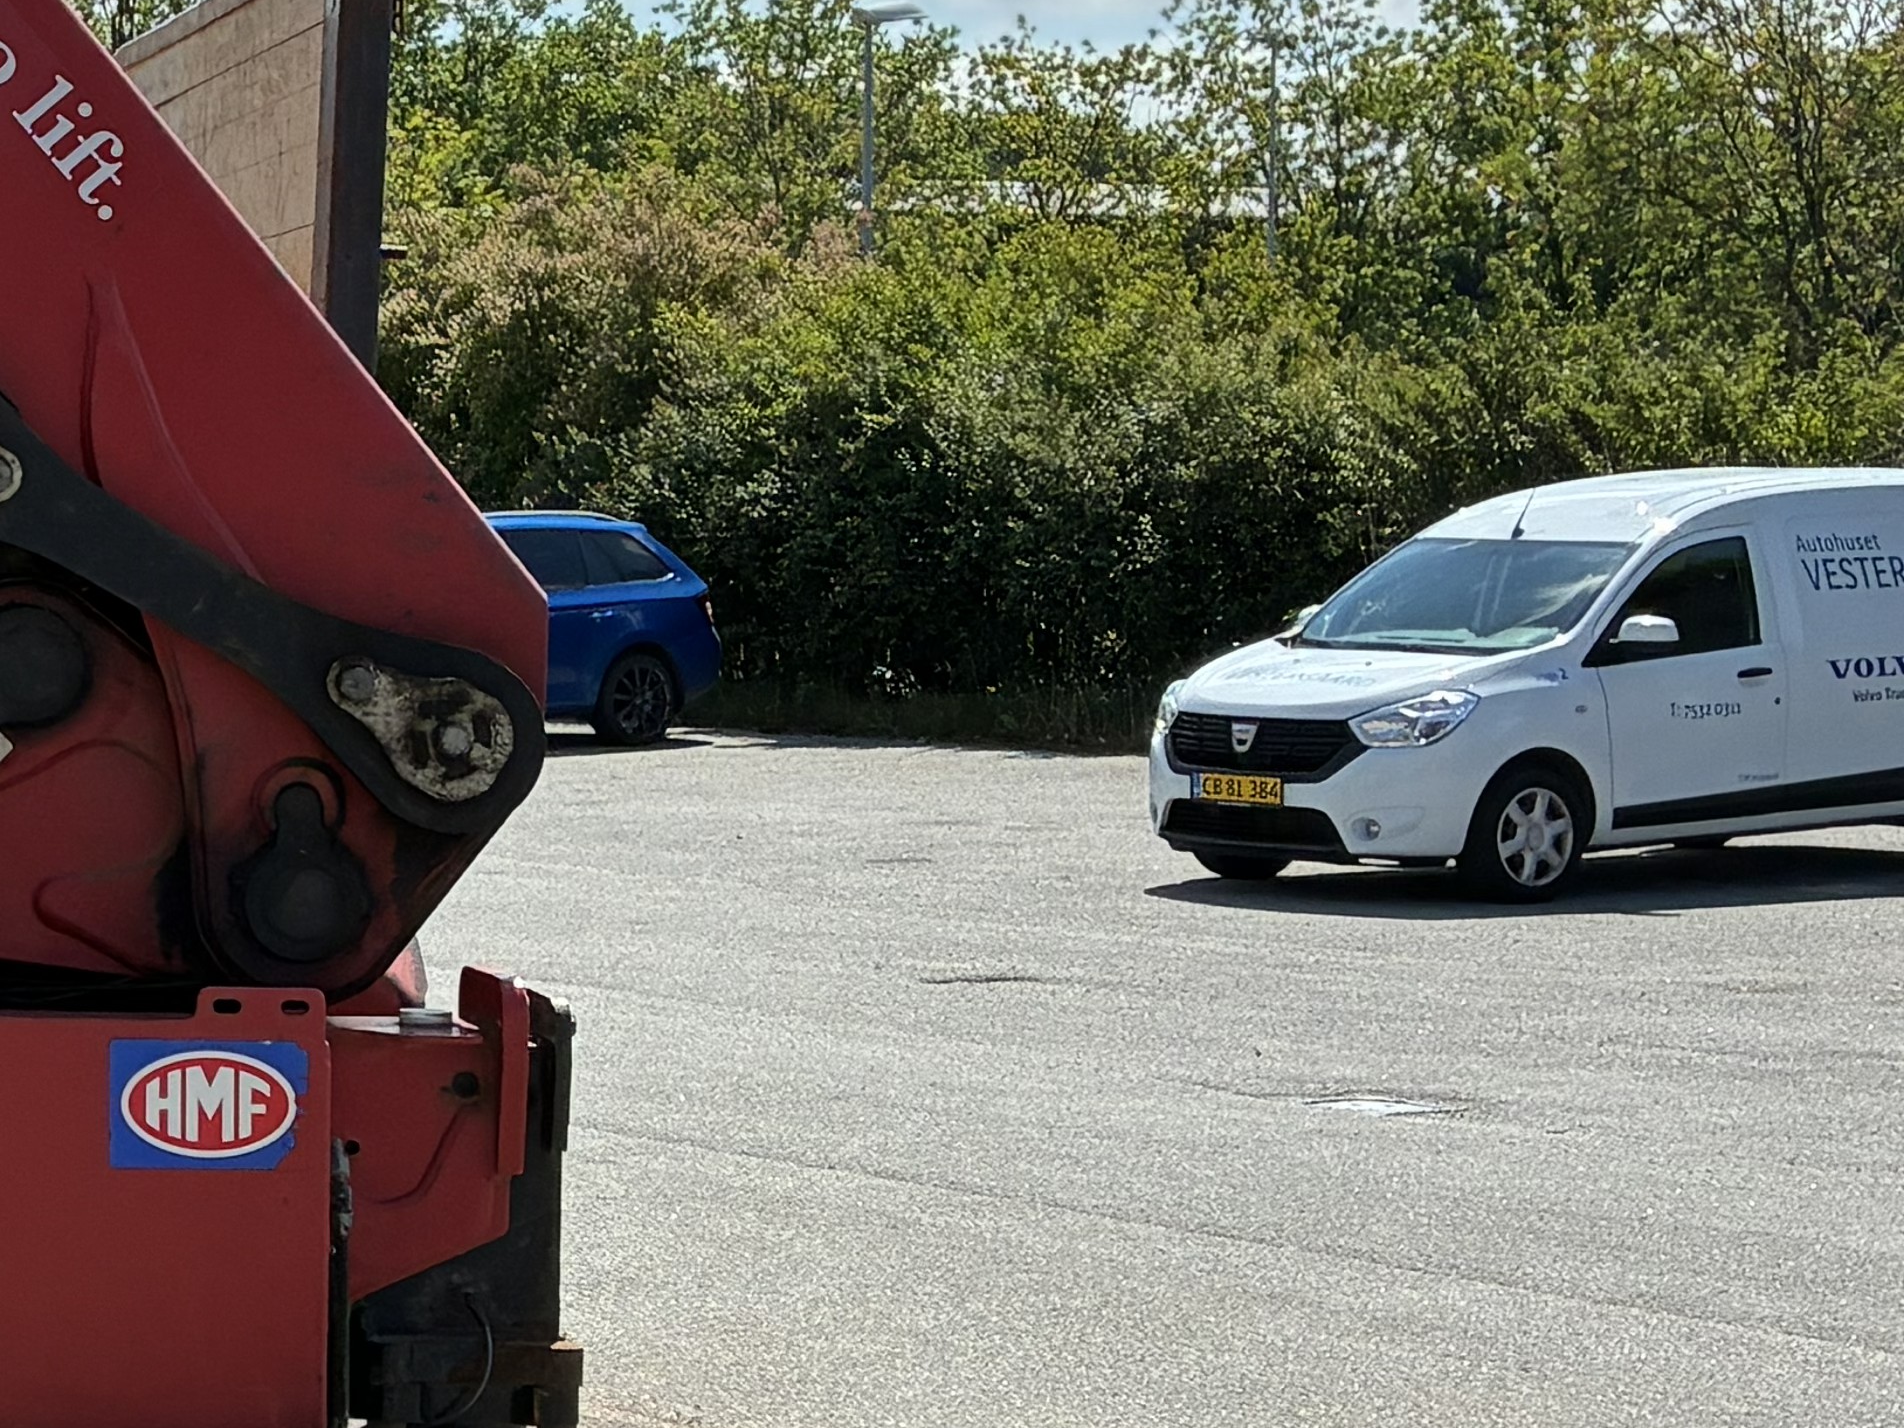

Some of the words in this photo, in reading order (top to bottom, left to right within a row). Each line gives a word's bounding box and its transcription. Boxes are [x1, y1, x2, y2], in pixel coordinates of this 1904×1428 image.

[11, 74, 128, 223] lift.
[1796, 533, 1881, 553] Autohuset
[1801, 556, 1904, 590] VESTER
[146, 1066, 271, 1142] HMF
